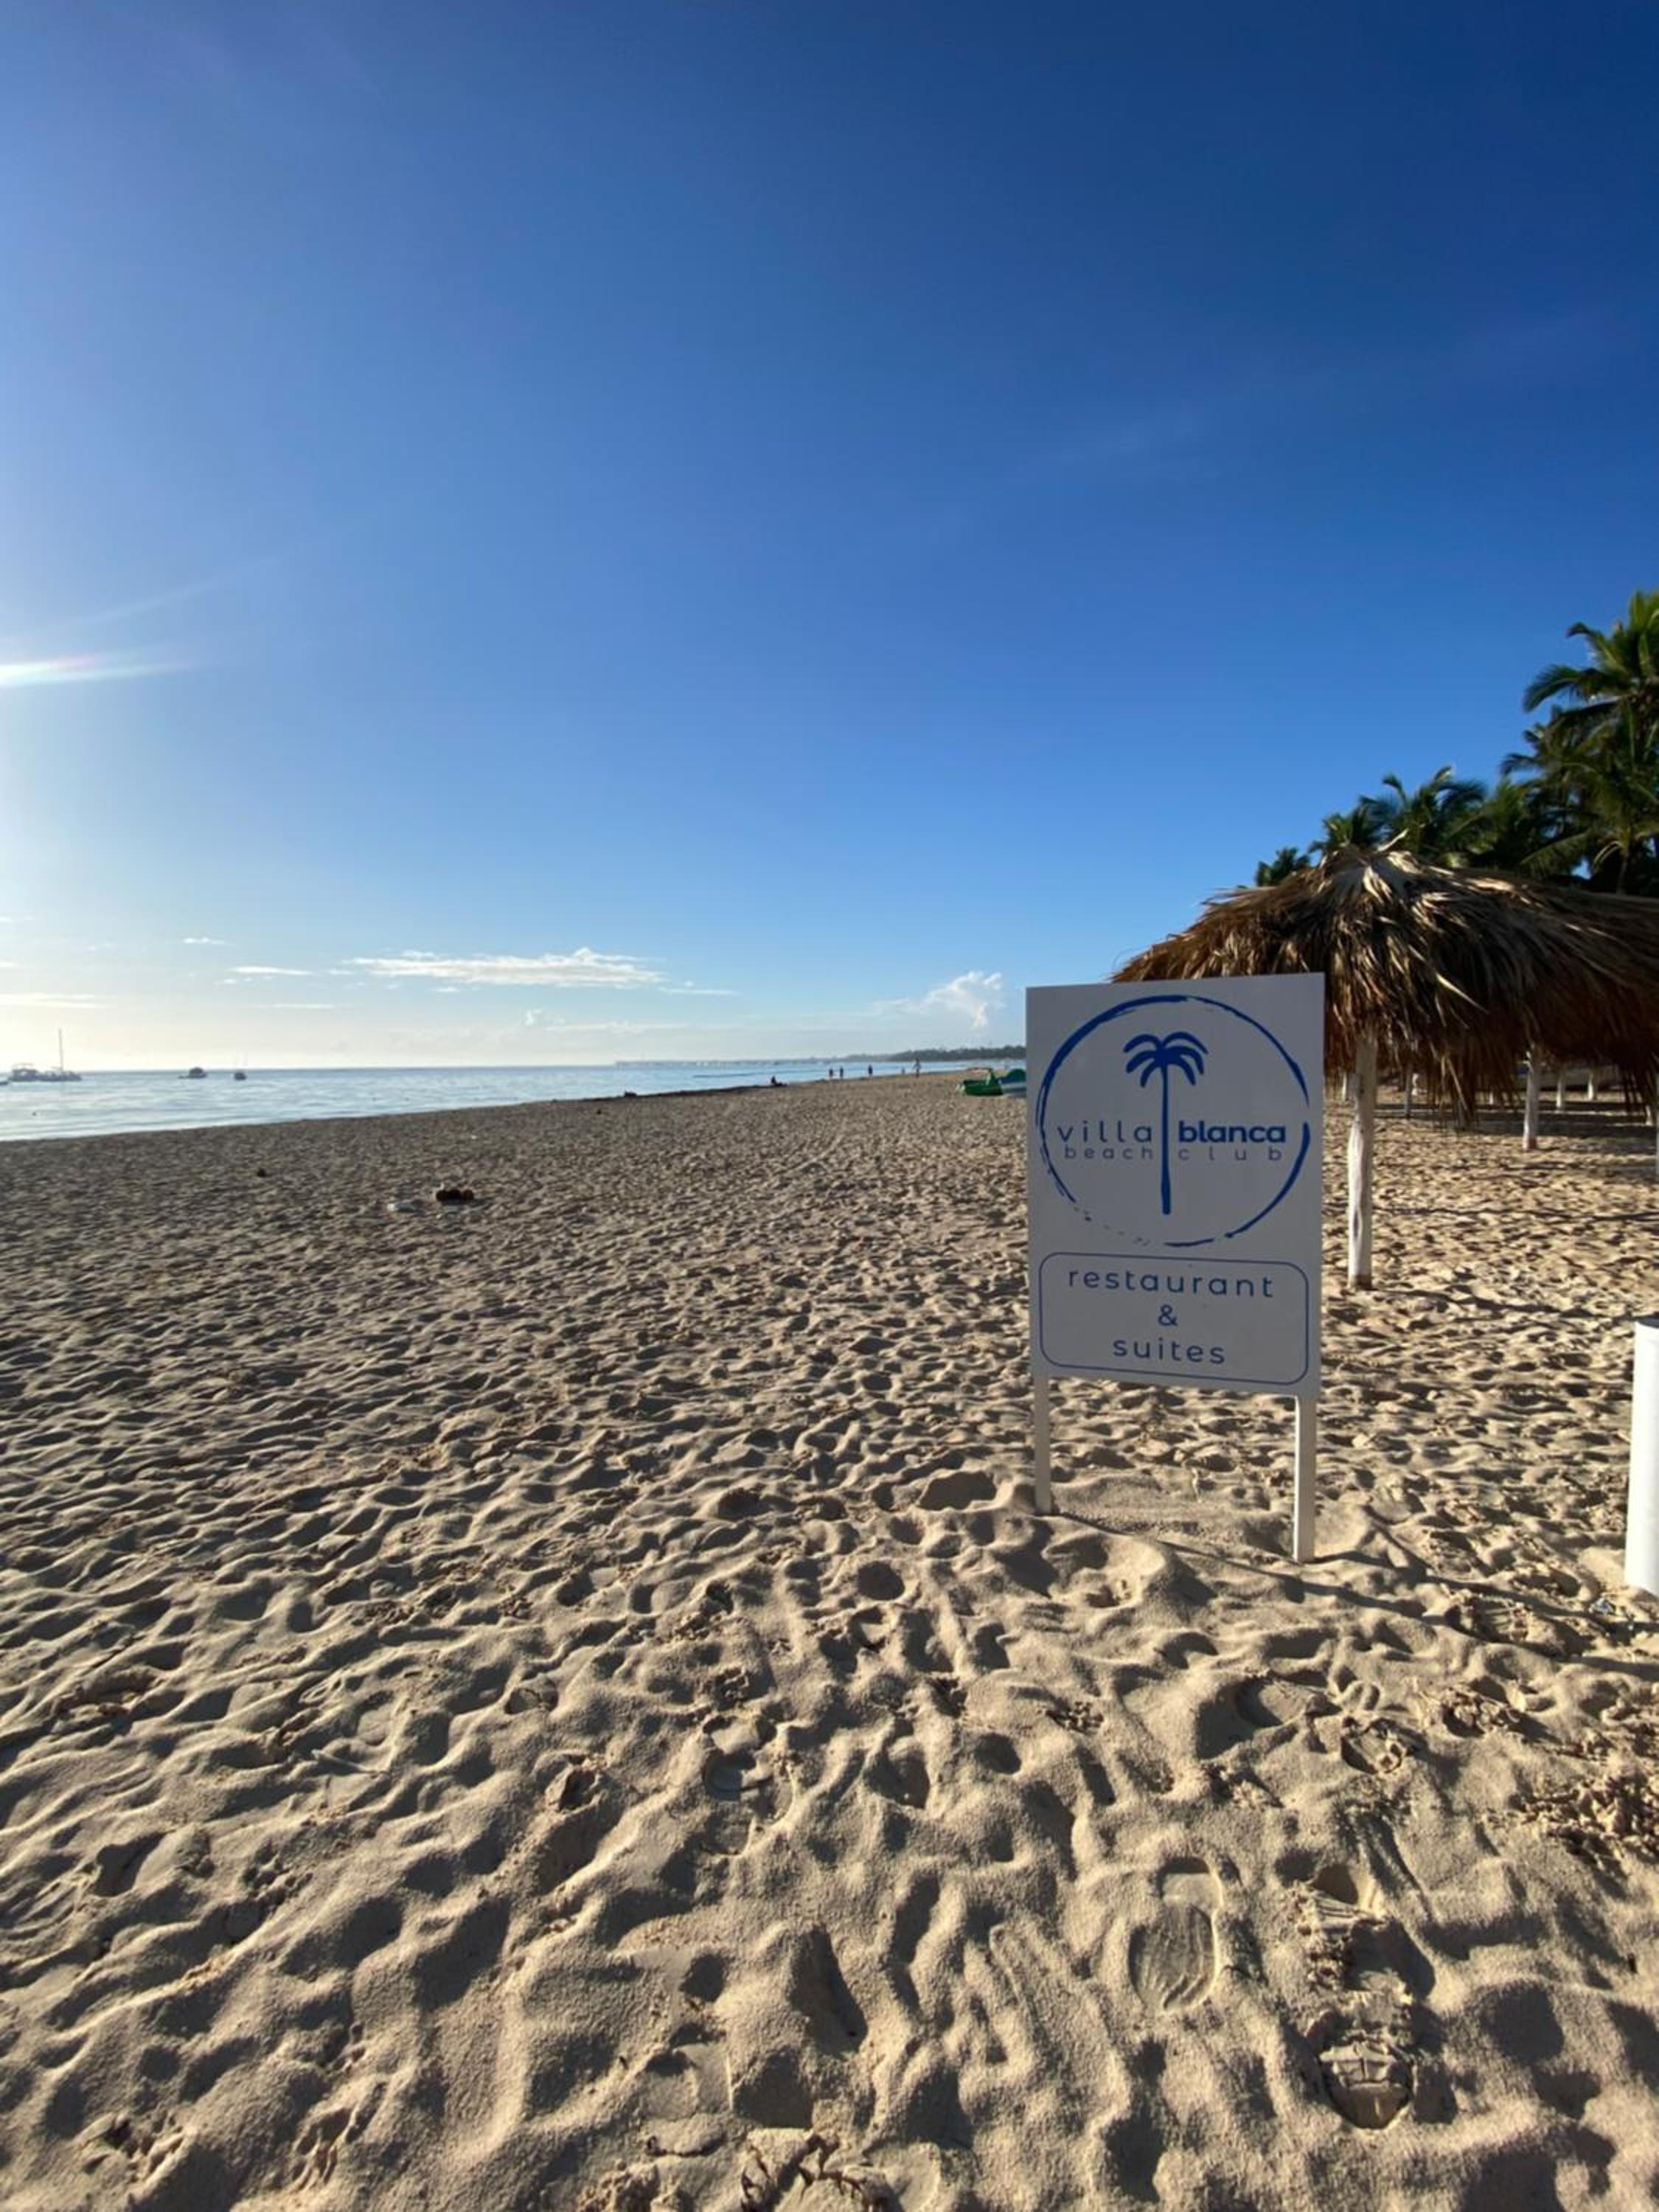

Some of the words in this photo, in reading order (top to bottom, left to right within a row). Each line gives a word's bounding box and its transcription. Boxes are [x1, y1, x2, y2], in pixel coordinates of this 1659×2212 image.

[1057, 1121, 1152, 1143] villa
[1179, 1121, 1286, 1143] blanca
[1065, 1146, 1152, 1160] beach
[1179, 1146, 1281, 1161] club
[1068, 1270, 1273, 1298] restaurant
[1158, 1304, 1178, 1326] &
[1113, 1338, 1225, 1365] suites
